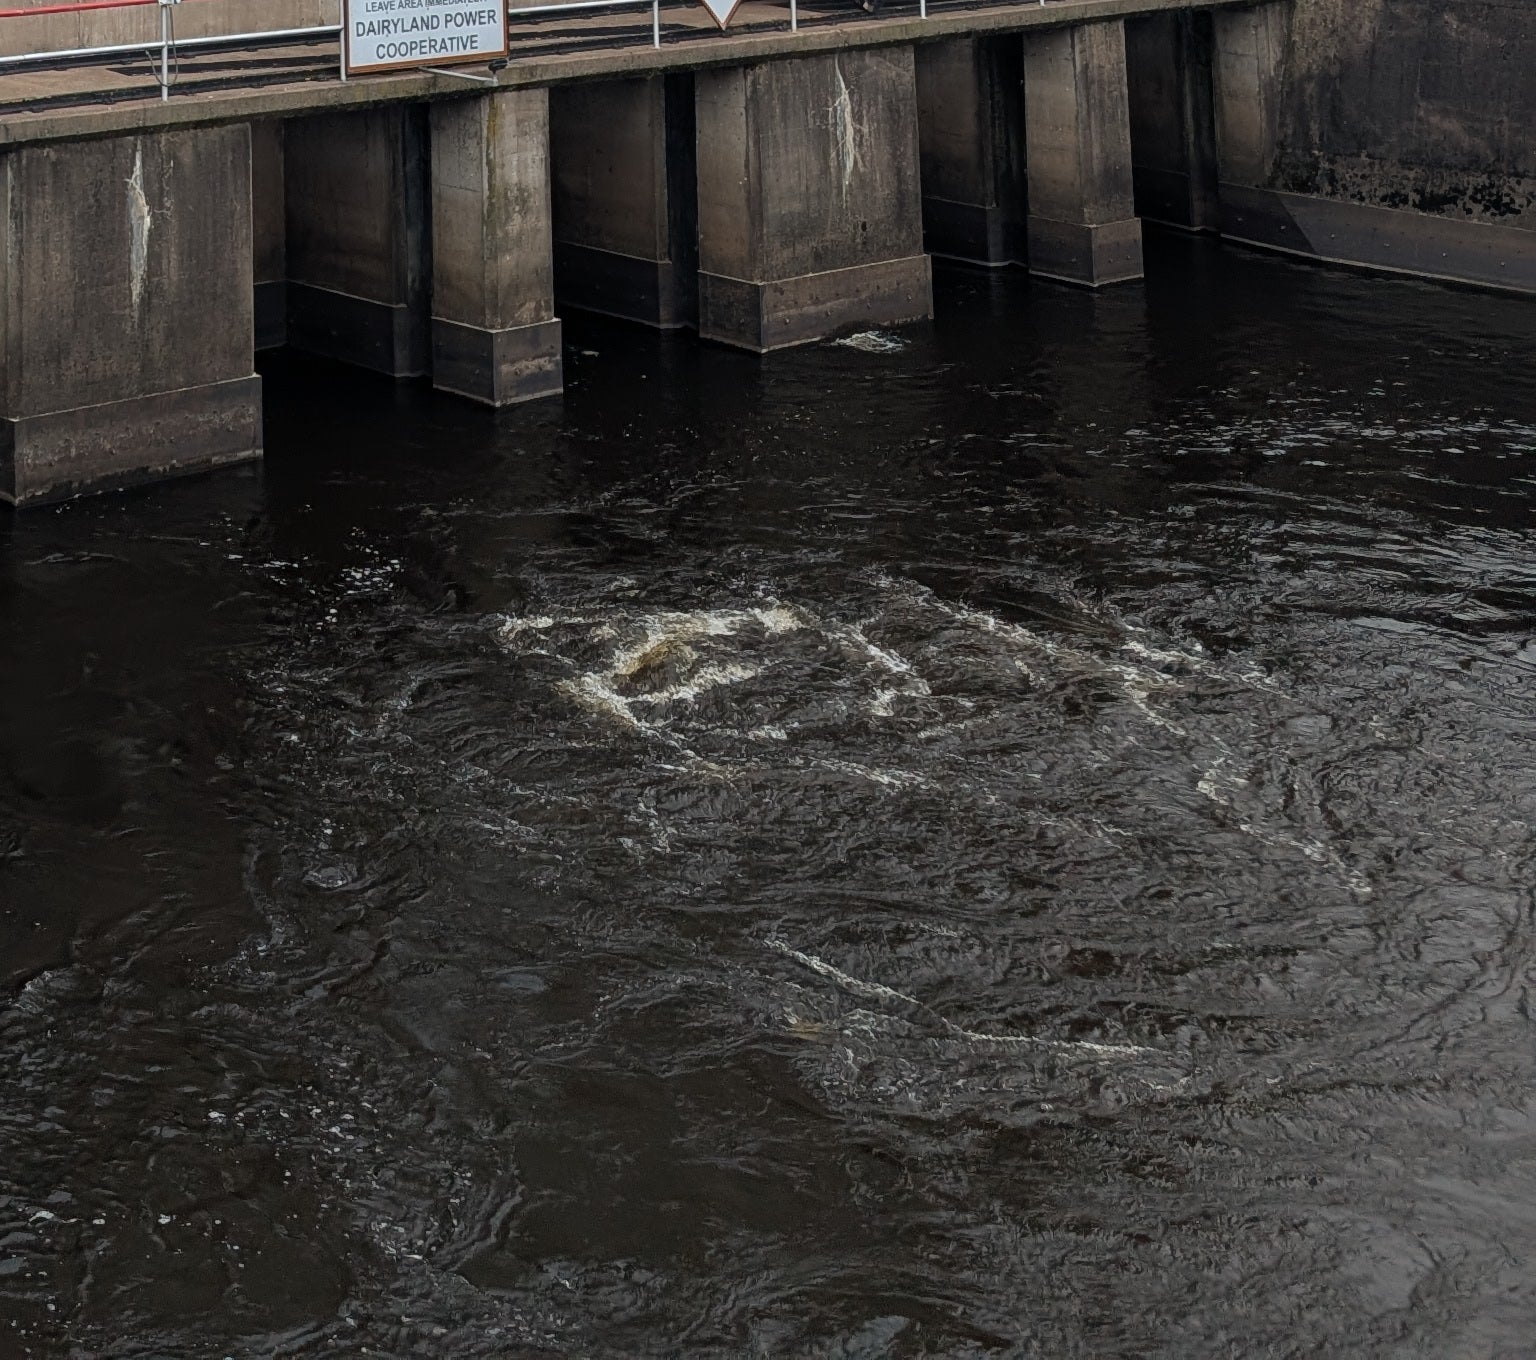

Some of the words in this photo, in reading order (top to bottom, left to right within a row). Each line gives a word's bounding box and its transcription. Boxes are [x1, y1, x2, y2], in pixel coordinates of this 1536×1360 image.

[365, 1, 396, 13] LEAVE
[356, 15, 440, 37] DAIRYLAND
[444, 9, 497, 29] POWER
[376, 35, 479, 59] COOPERATIVE
